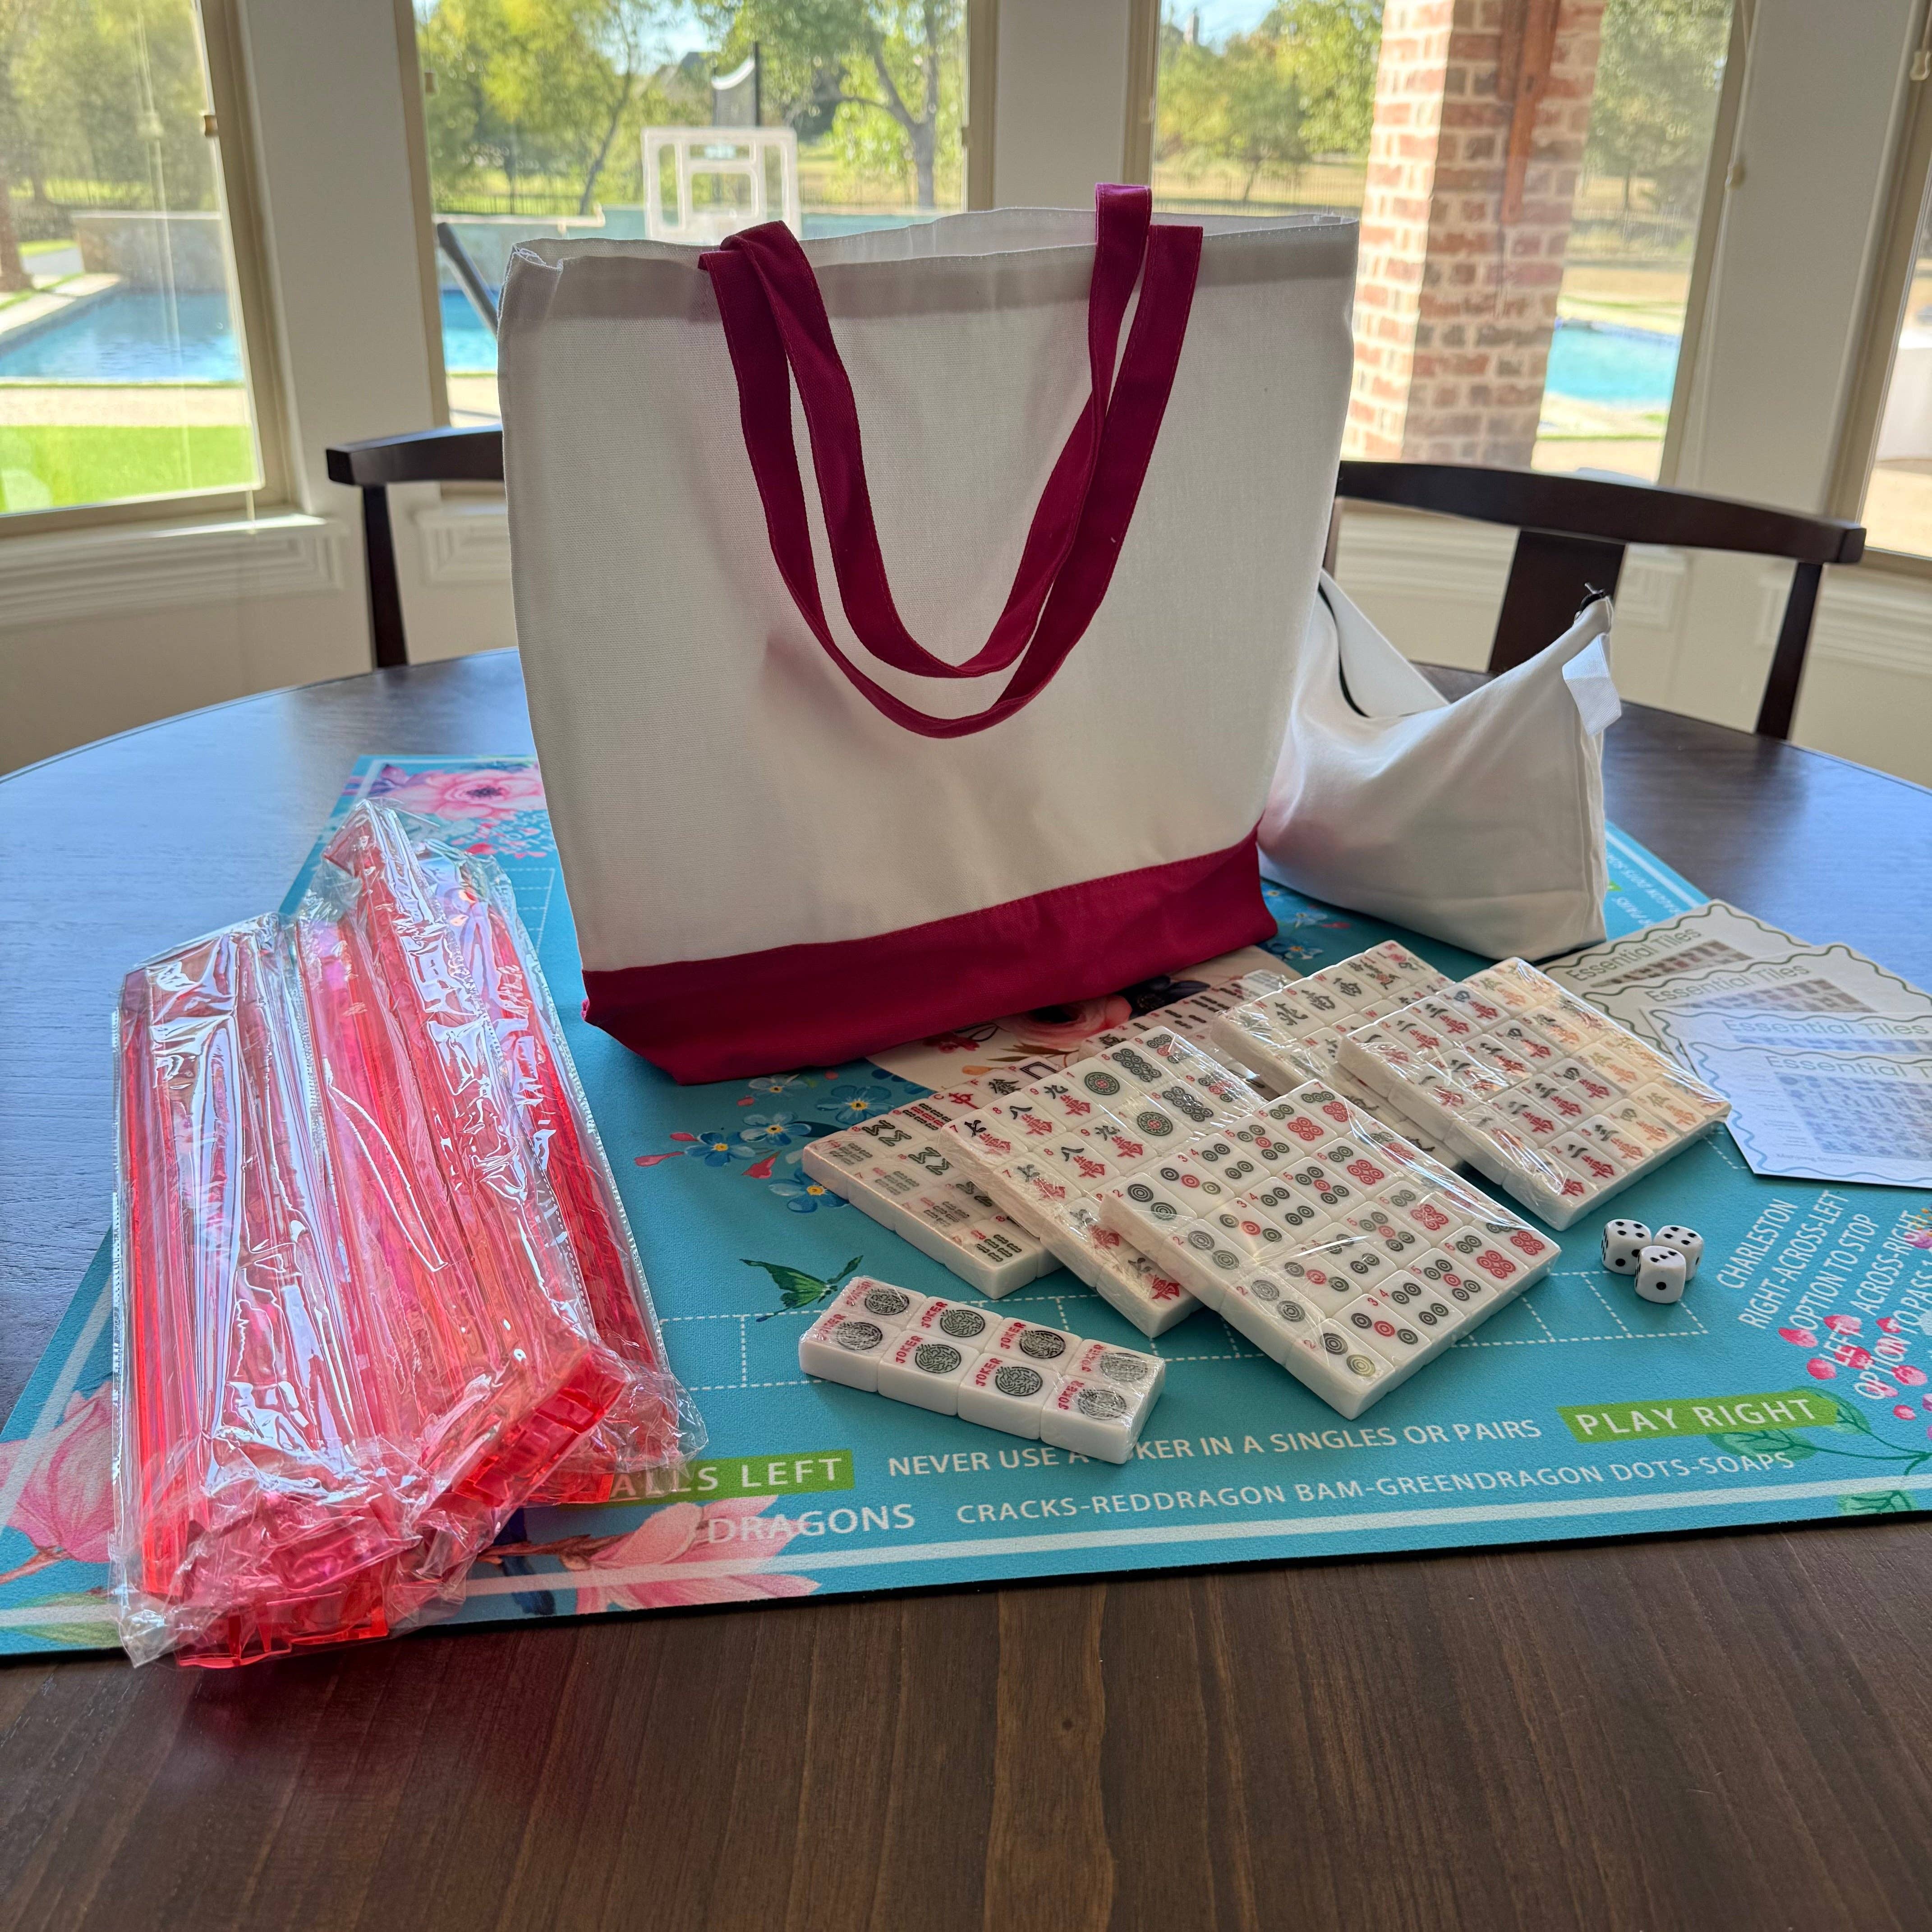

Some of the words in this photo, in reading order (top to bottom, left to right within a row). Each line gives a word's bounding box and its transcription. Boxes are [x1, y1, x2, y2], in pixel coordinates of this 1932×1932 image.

[1566, 943, 1659, 981] Essential
[1650, 929, 1702, 949] Tiles
[1646, 975, 1755, 1002] Essential
[1750, 966, 1810, 982] Tiles
[1722, 1020, 1854, 1035] Essential
[1858, 1022, 1929, 1035] Tiles
[1764, 1055, 1908, 1077] Essential
[1044, 1084, 1091, 1116] 九萬
[949, 1125, 958, 1133] 7
[1009, 1105, 1053, 1136] 八萬
[1225, 1129, 1235, 1137] 5
[1095, 1125, 1143, 1158] 九萬
[1551, 1145, 1562, 1154] 2
[1061, 1146, 1105, 1178] 八萬
[1178, 1155, 1188, 1163] 3
[1317, 1152, 1327, 1160] 6
[1002, 1169, 1012, 1178] 7
[1283, 1172, 1293, 1180] 5
[1113, 1189, 1124, 1198] 2
[1237, 1200, 1247, 1208] 3
[1249, 1192, 1259, 1201] 4
[1379, 1196, 1389, 1205] 6
[1347, 1218, 1357, 1226] 5
[1838, 1213, 1879, 1252] STOP
[1173, 1236, 1184, 1246] 2
[1444, 1242, 1455, 1251] 6
[1716, 1198, 1799, 1289] CHARLESTON
[1411, 1265, 1422, 1274] 5
[1738, 1190, 1849, 1329] RIGHT-ACROSS-LEFT
[1823, 1250, 1858, 1272] TO
[1236, 1286, 1248, 1296] 2
[1367, 1297, 1379, 1306] 3
[1379, 1289, 1390, 1298] 4
[1789, 1270, 1847, 1331] OPTION
[1819, 1322, 1864, 1367] LEFT
[1850, 1210, 1928, 1316] ACROSS-RIGHT
[921, 1302, 948, 1328] JOKER
[1000, 1322, 1026, 1349] JOKER
[1303, 1339, 1316, 1349] 2
[895, 1335, 923, 1364] JOKER
[1081, 1344, 1104, 1372] JOKER
[1854, 1332, 1912, 1400] OPTION
[1888, 1310, 1921, 1334] TO
[975, 1357, 1003, 1387] JOKER
[1058, 1380, 1085, 1410] JOKER
[1575, 1407, 1679, 1435] PLAY
[1692, 1398, 1816, 1427] RIGHT
[889, 1451, 990, 1477] NEVER
[998, 1447, 1060, 1469] USE
[1127, 1439, 1195, 1460] KER
[1200, 1436, 1234, 1456] IN
[1242, 1435, 1265, 1454] A
[1270, 1428, 1398, 1453] SINGLES
[1403, 1425, 1449, 1444] OR
[1451, 1419, 1542, 1442] PAIRS
[610, 1466, 719, 1499] ALLS
[741, 1457, 842, 1488] LEFT
[957, 1484, 1285, 1523] CRACKS-REDDRAGON
[1294, 1465, 1604, 1502] BAM-GREENDRAGON
[1610, 1452, 1795, 1481] DOTS-SOAPS
[708, 1503, 915, 1544] DRAGONS
